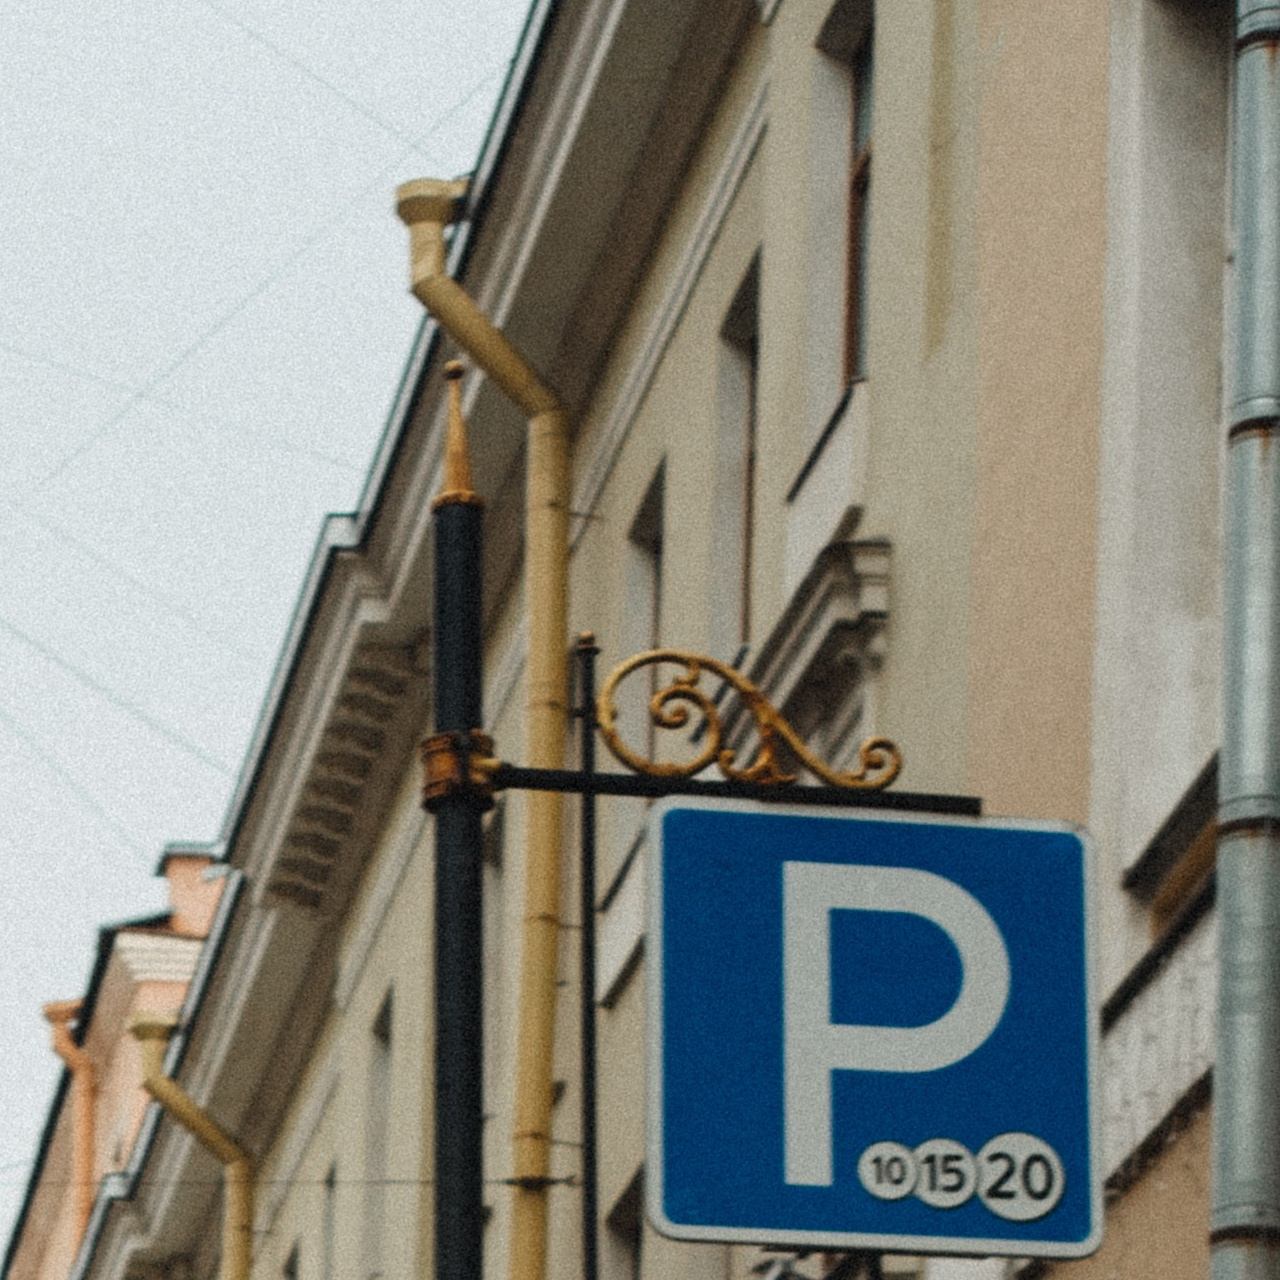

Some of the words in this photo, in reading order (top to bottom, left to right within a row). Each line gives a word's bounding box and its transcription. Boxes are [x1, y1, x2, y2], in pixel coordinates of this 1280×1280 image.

[783, 860, 1011, 1187] P
[872, 1156, 906, 1185] 10
[923, 1154, 966, 1193] 15
[986, 1152, 1054, 1200] 20
